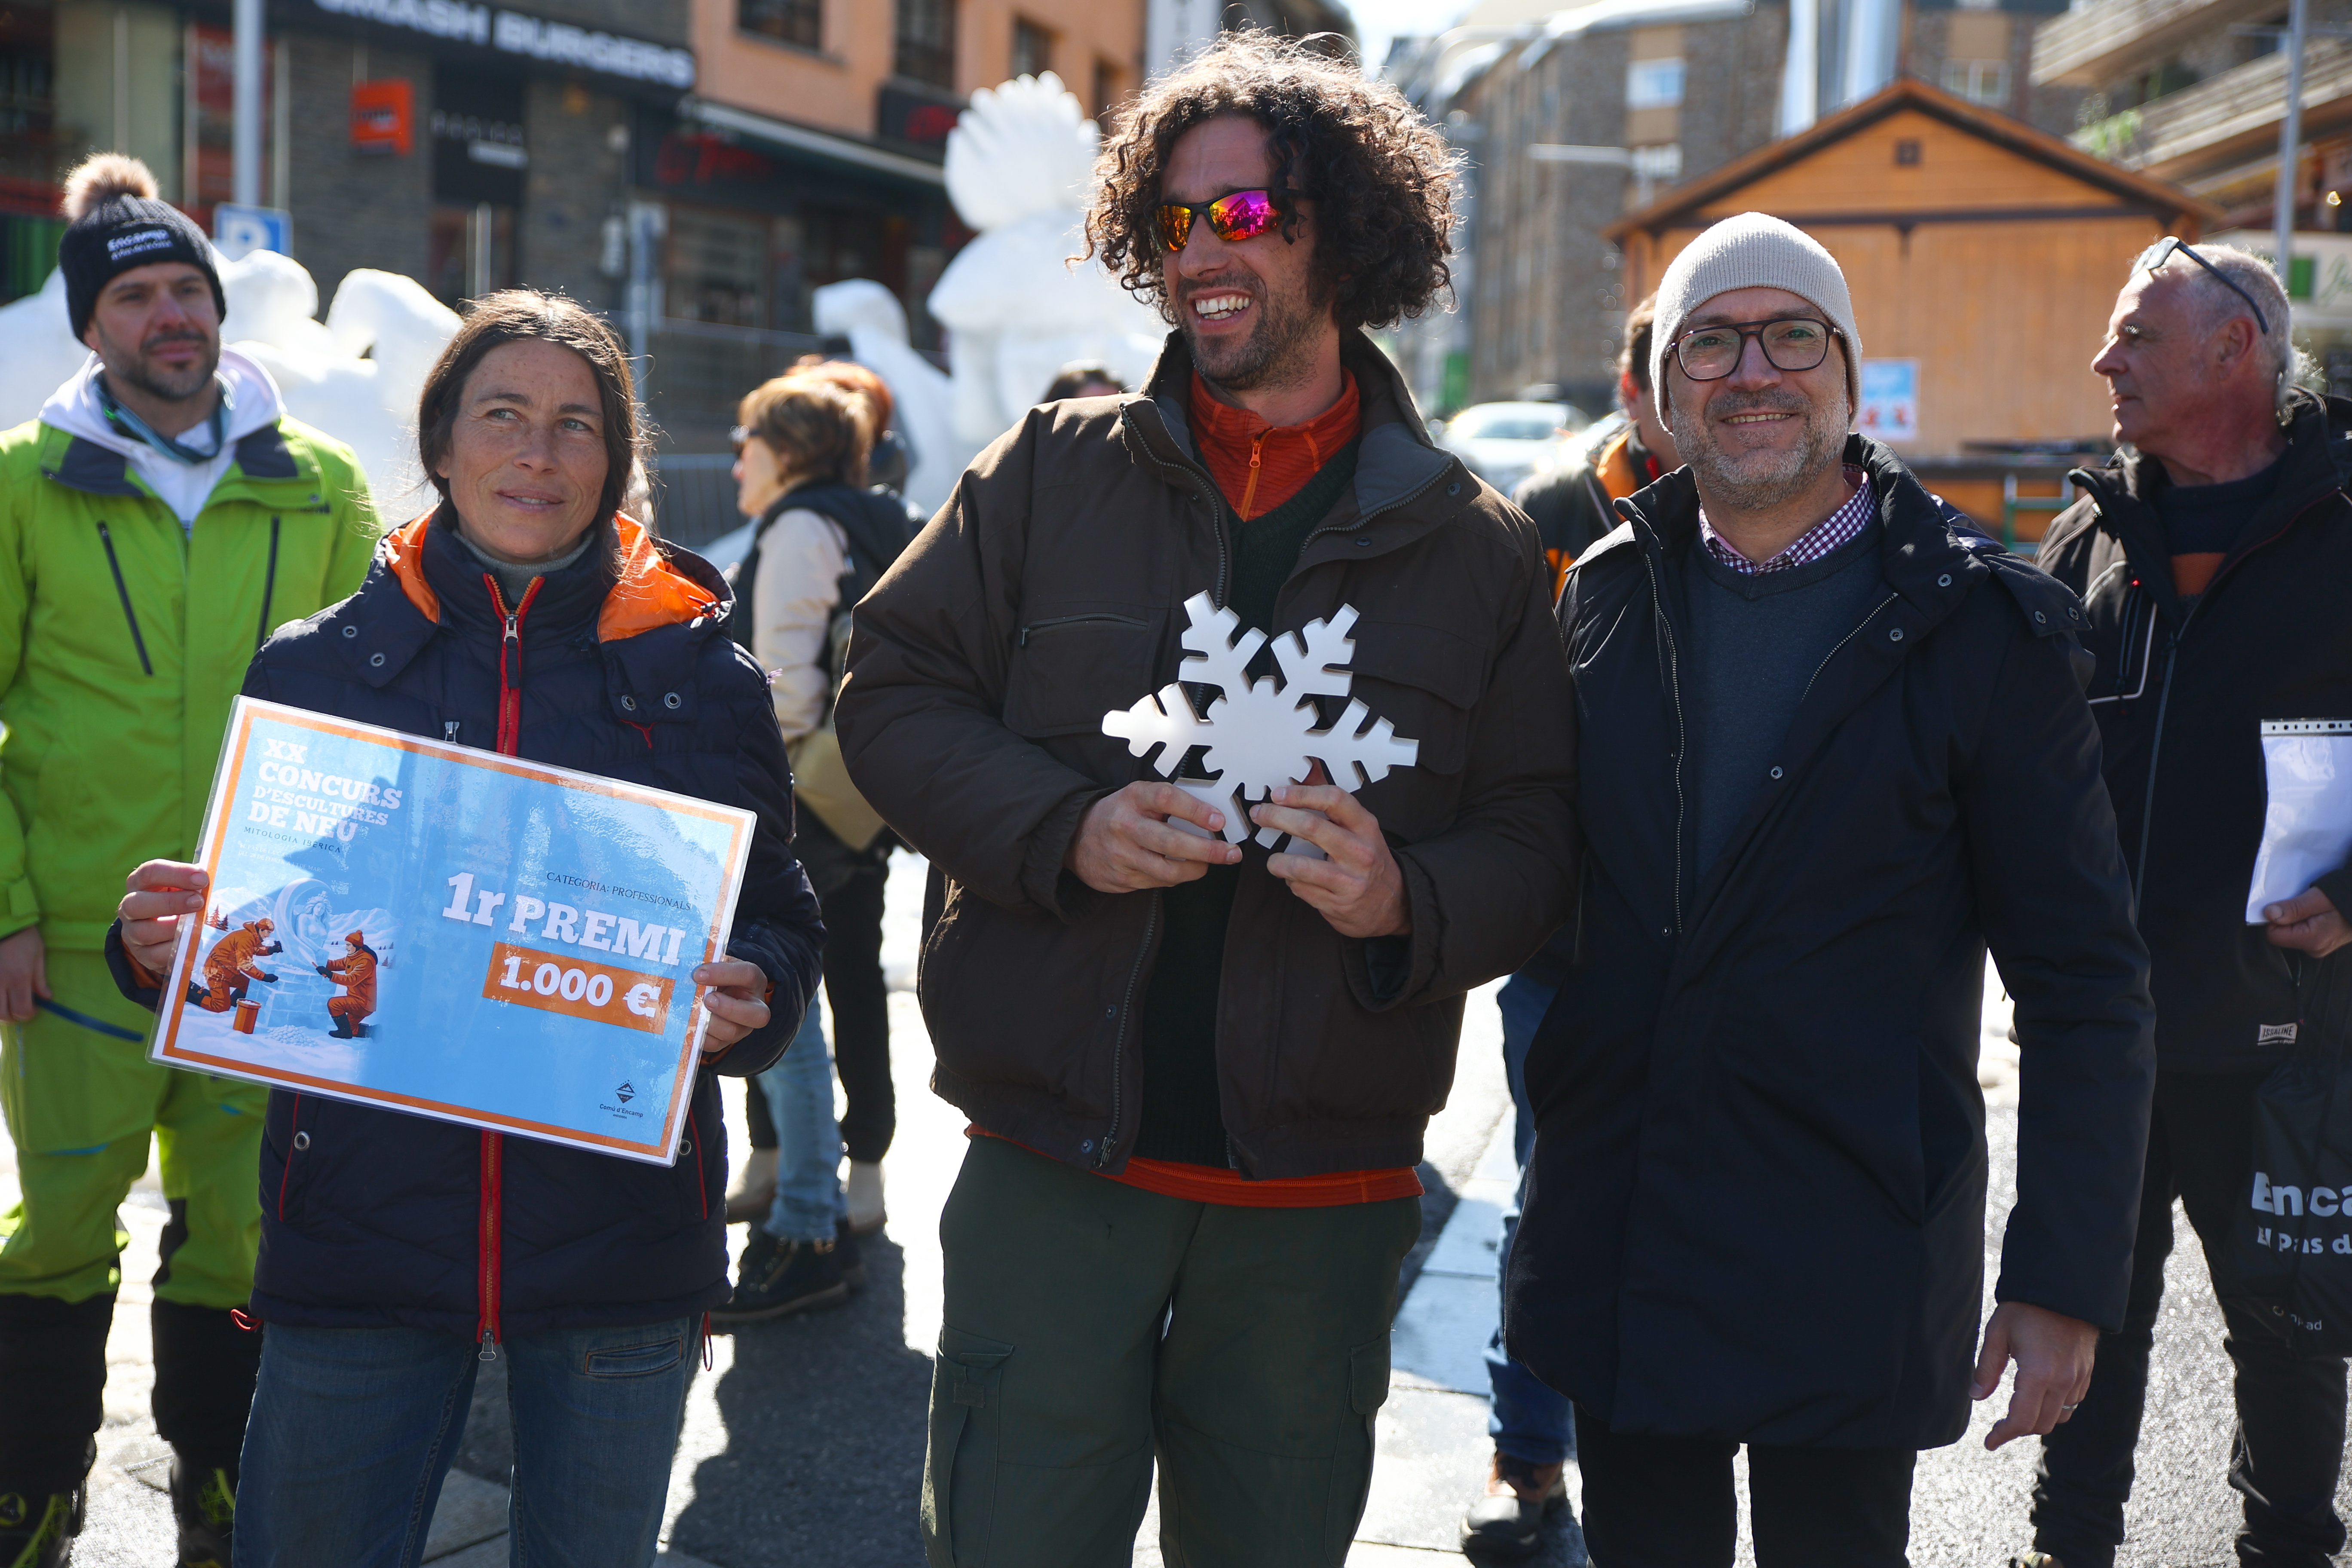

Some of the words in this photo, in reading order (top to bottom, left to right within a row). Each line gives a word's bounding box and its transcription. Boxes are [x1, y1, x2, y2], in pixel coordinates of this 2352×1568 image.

[493, 9, 695, 88] BURGERS
[263, 738, 308, 764] XX
[253, 785, 389, 826] D'ESCULTURES
[259, 761, 403, 809] CONCURS
[244, 826, 297, 844] MITOLOGIA
[248, 800, 289, 828] DE
[293, 811, 358, 842] NEU
[547, 872, 610, 893] CATEGORIA:
[612, 886, 692, 911] PROFESSIONALS
[442, 872, 505, 926] 1r
[508, 895, 686, 966] PREMI
[500, 956, 613, 1006] 1.000
[623, 983, 660, 1017] €
[600, 1103, 616, 1112] Comú
[616, 1107, 643, 1118] d'Encamp
